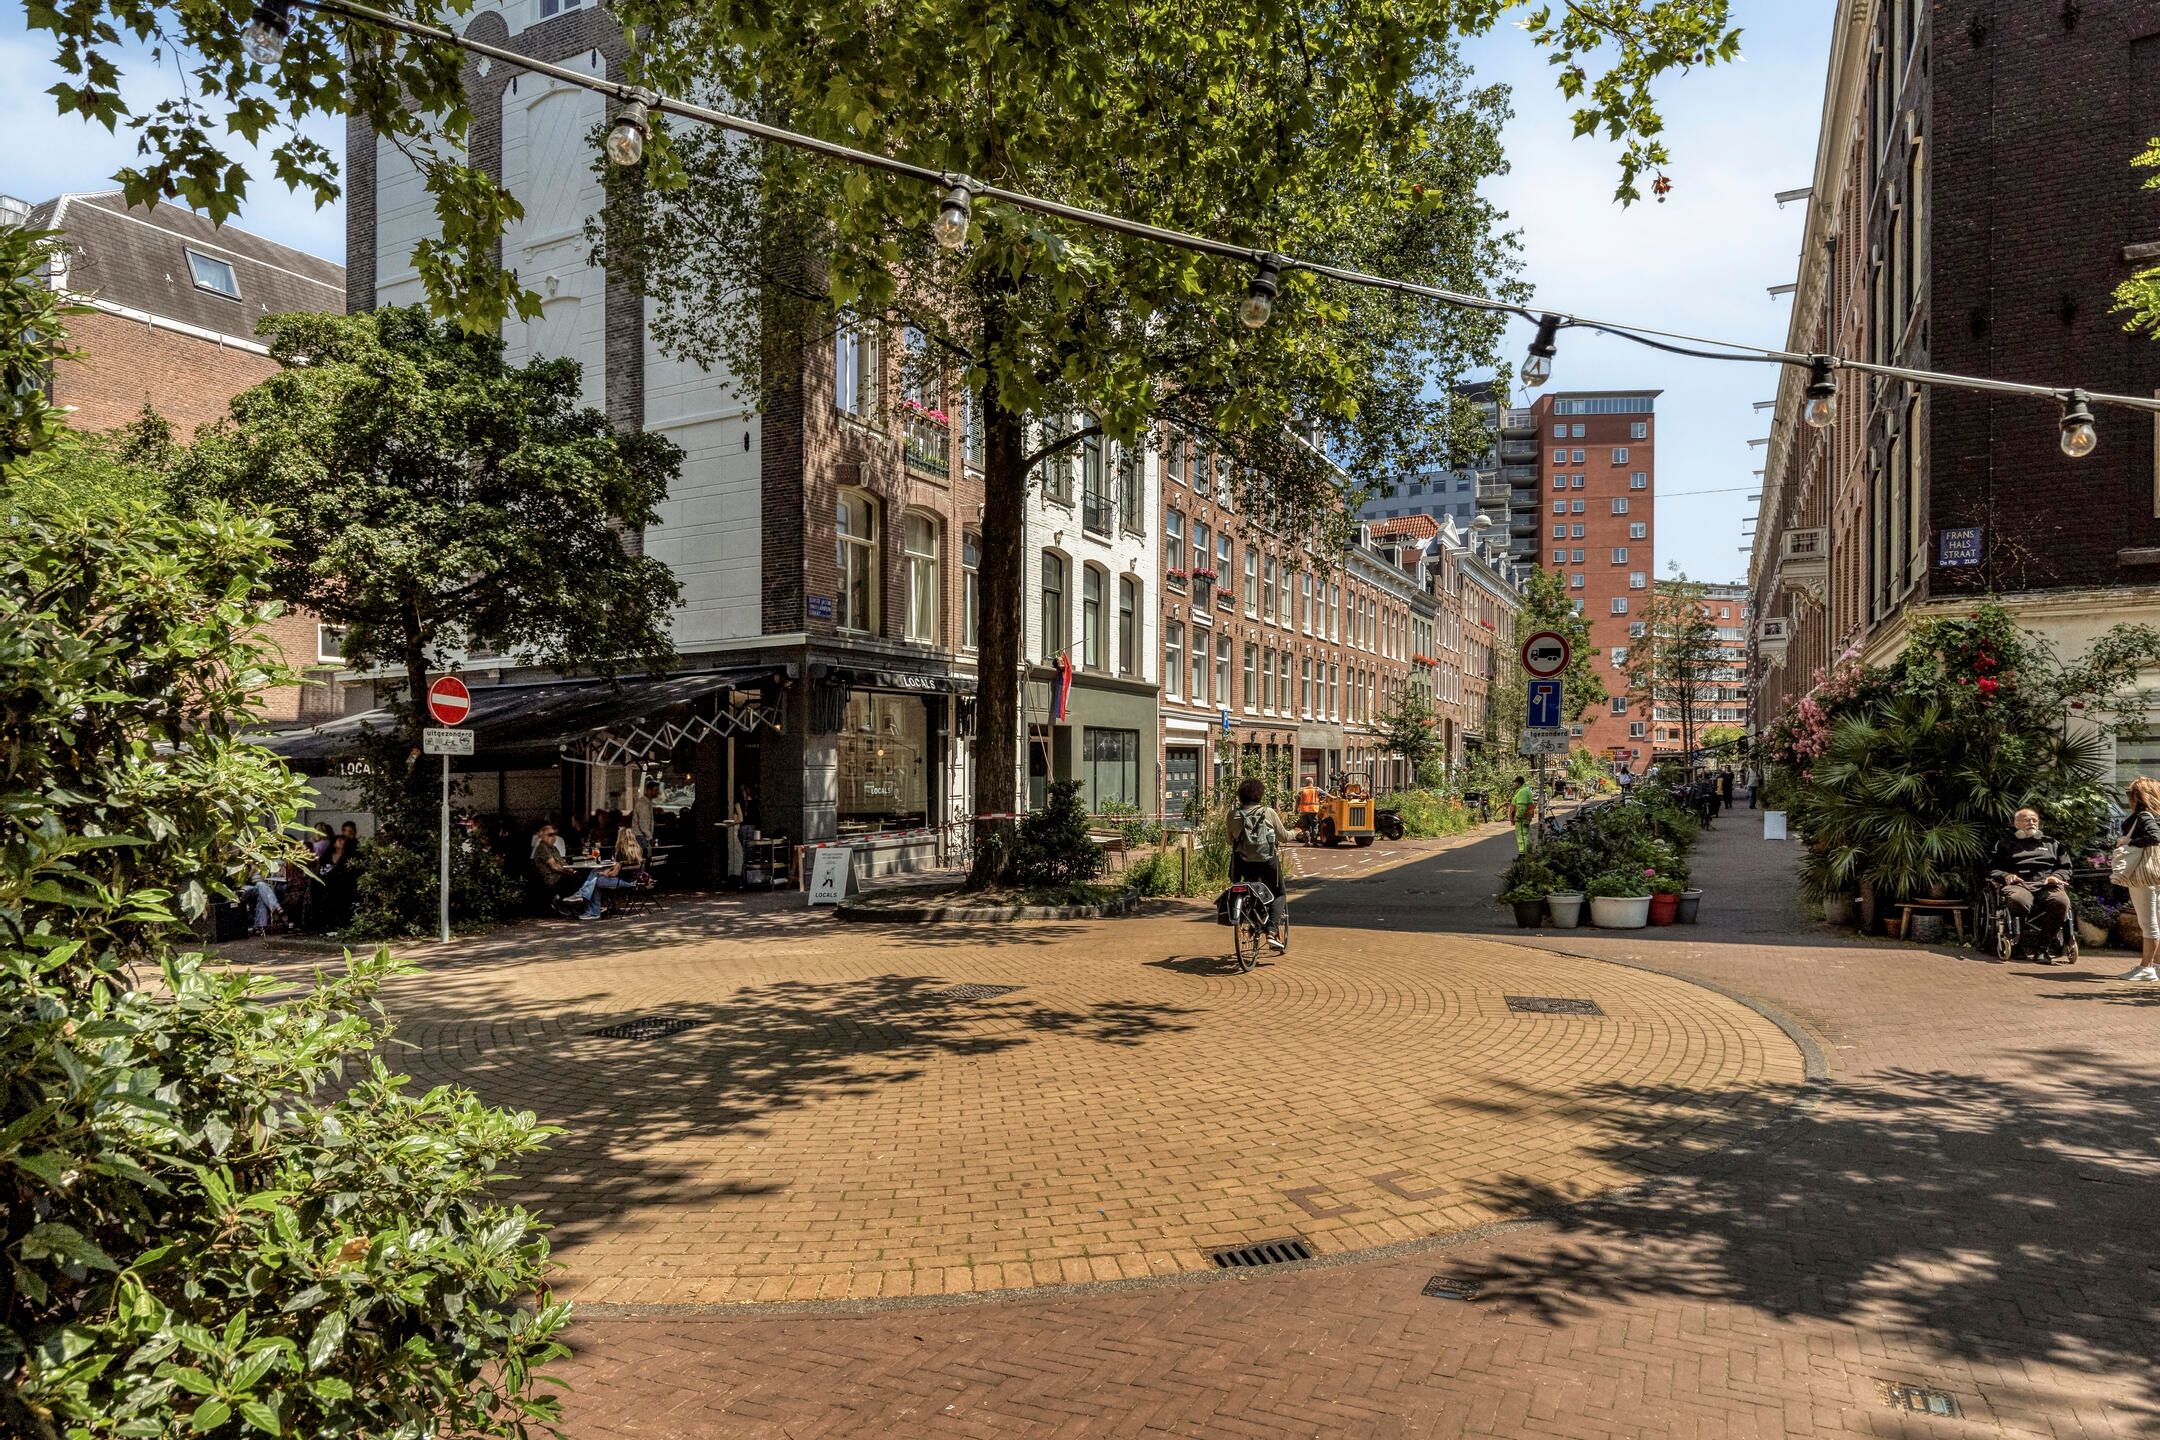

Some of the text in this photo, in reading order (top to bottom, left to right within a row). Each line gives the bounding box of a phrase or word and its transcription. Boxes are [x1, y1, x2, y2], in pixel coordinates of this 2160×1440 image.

[1946, 530, 1975, 540] FRANS
[1949, 540, 1971, 549] HALS
[1944, 549, 1977, 559] STRAAT
[903, 676, 936, 690] LOCALS
[1529, 730, 1568, 738] tgezonderd
[871, 787, 891, 795] LOCALS
